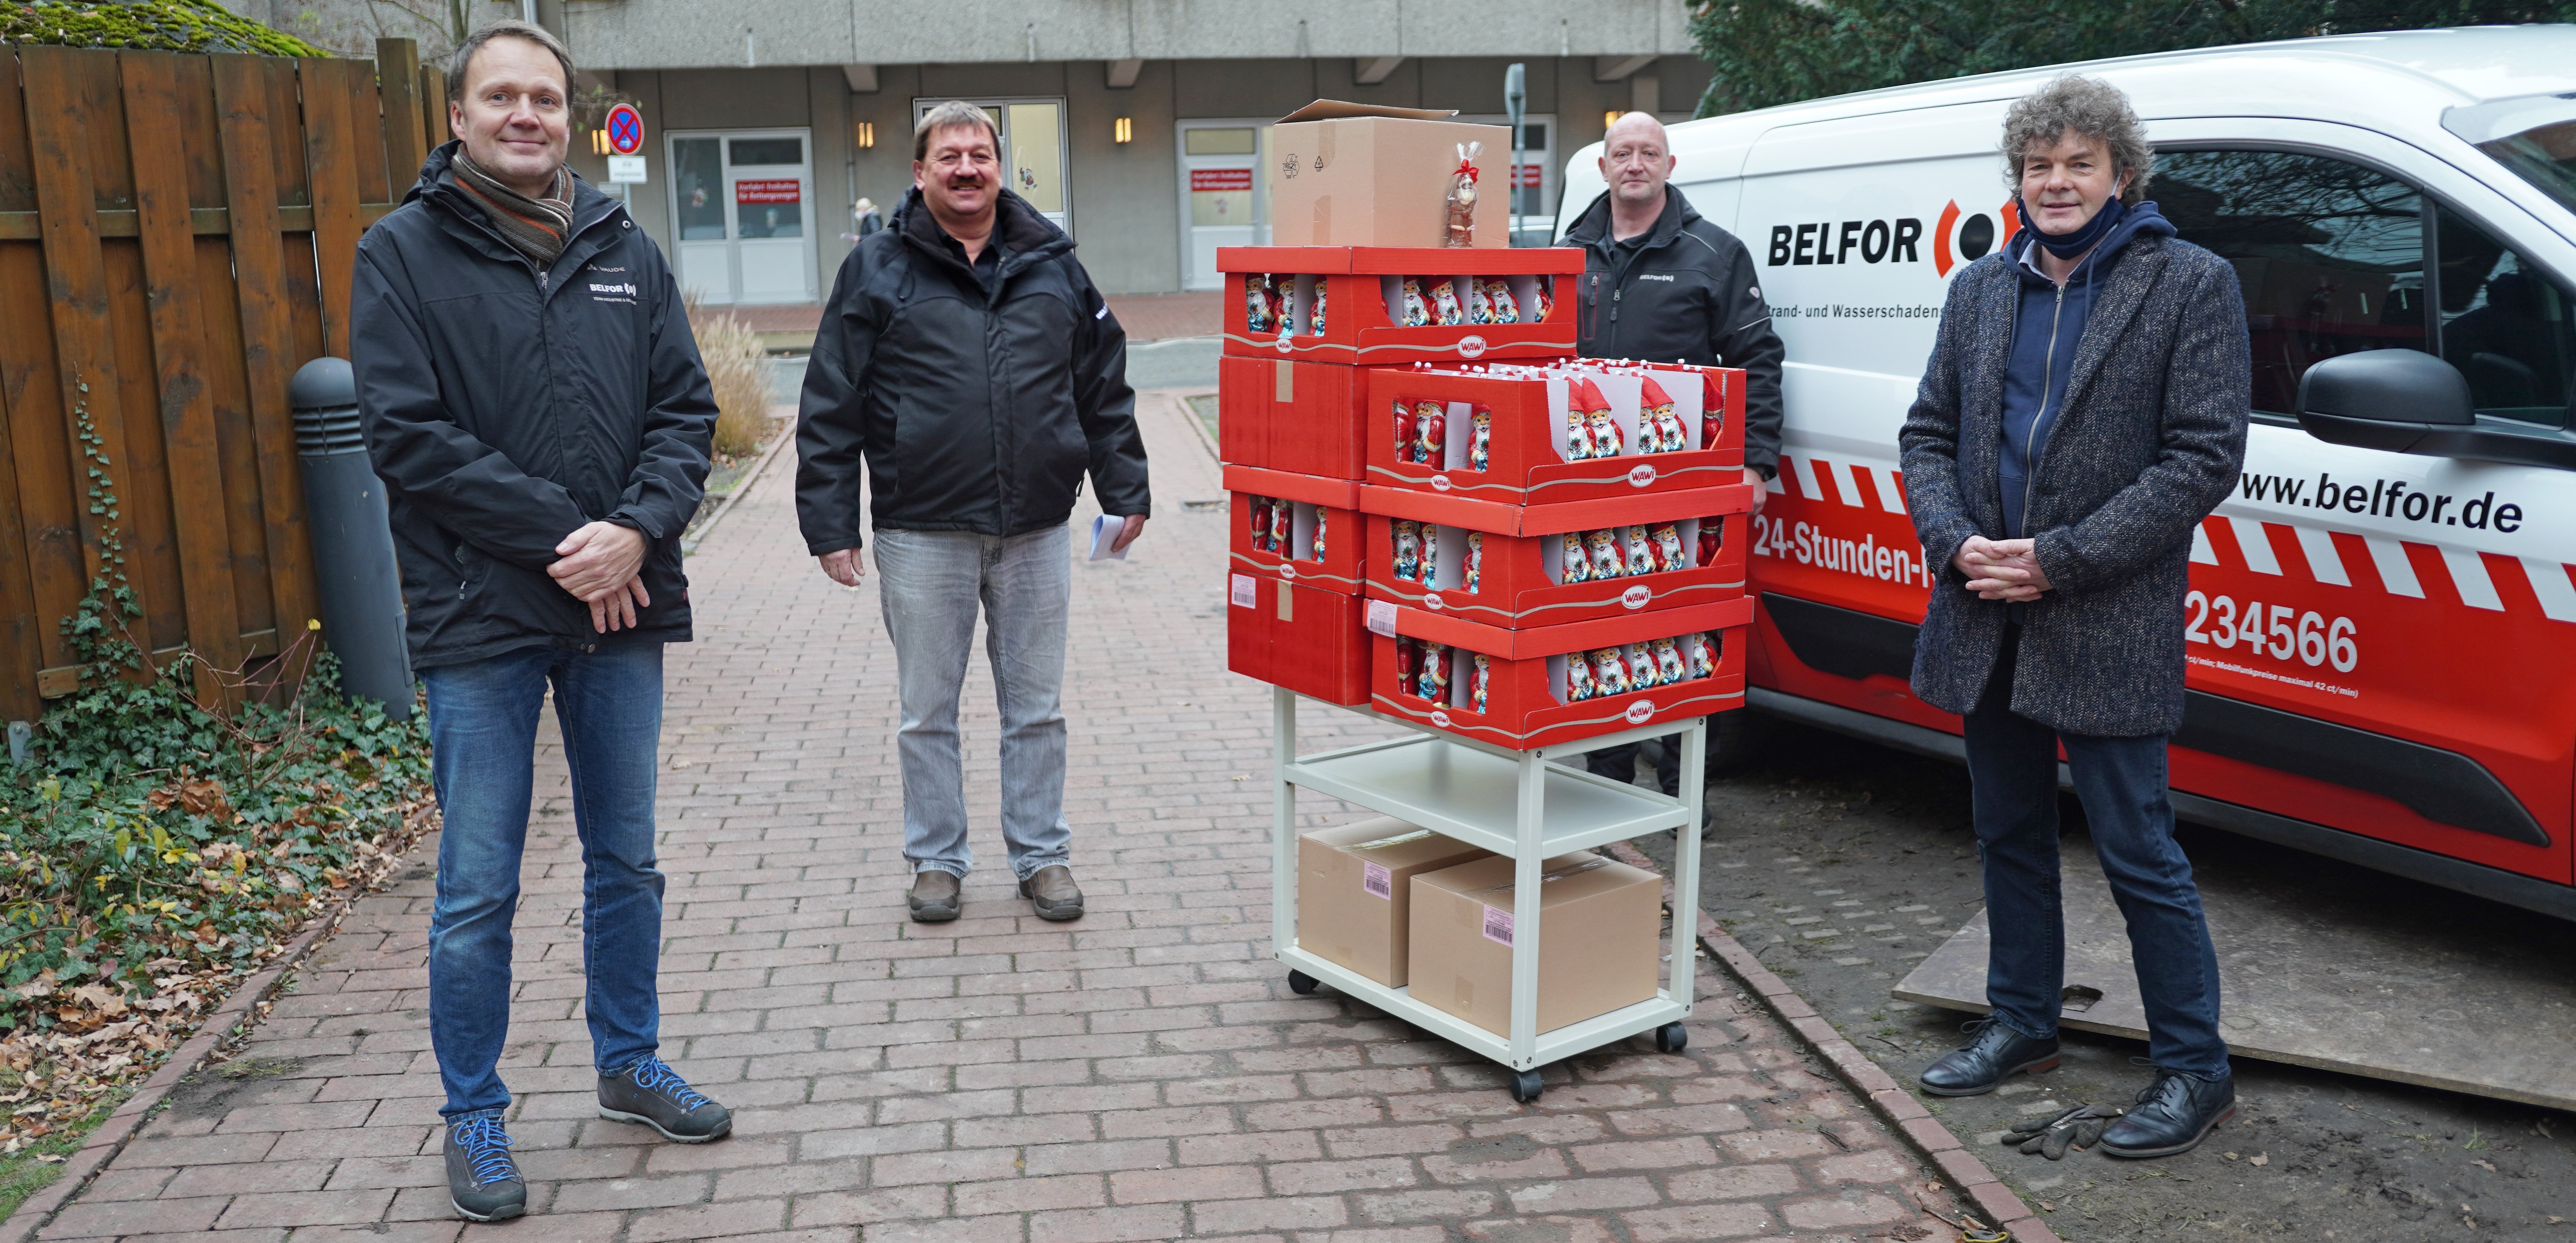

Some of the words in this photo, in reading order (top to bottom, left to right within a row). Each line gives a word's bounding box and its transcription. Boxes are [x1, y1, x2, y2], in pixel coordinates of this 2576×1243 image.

[1768, 218, 1922, 266] BELFOR
[589, 284, 624, 293] BELFOR
[1806, 304, 1828, 317] und
[2184, 590, 2358, 673] 234566
[2188, 655, 2216, 668] ct/min;
[2216, 661, 2278, 680] Mobilfunkpreise
[2278, 675, 2314, 688] maximal
[2314, 682, 2326, 691] 42
[2327, 685, 2359, 699] ct/min)
